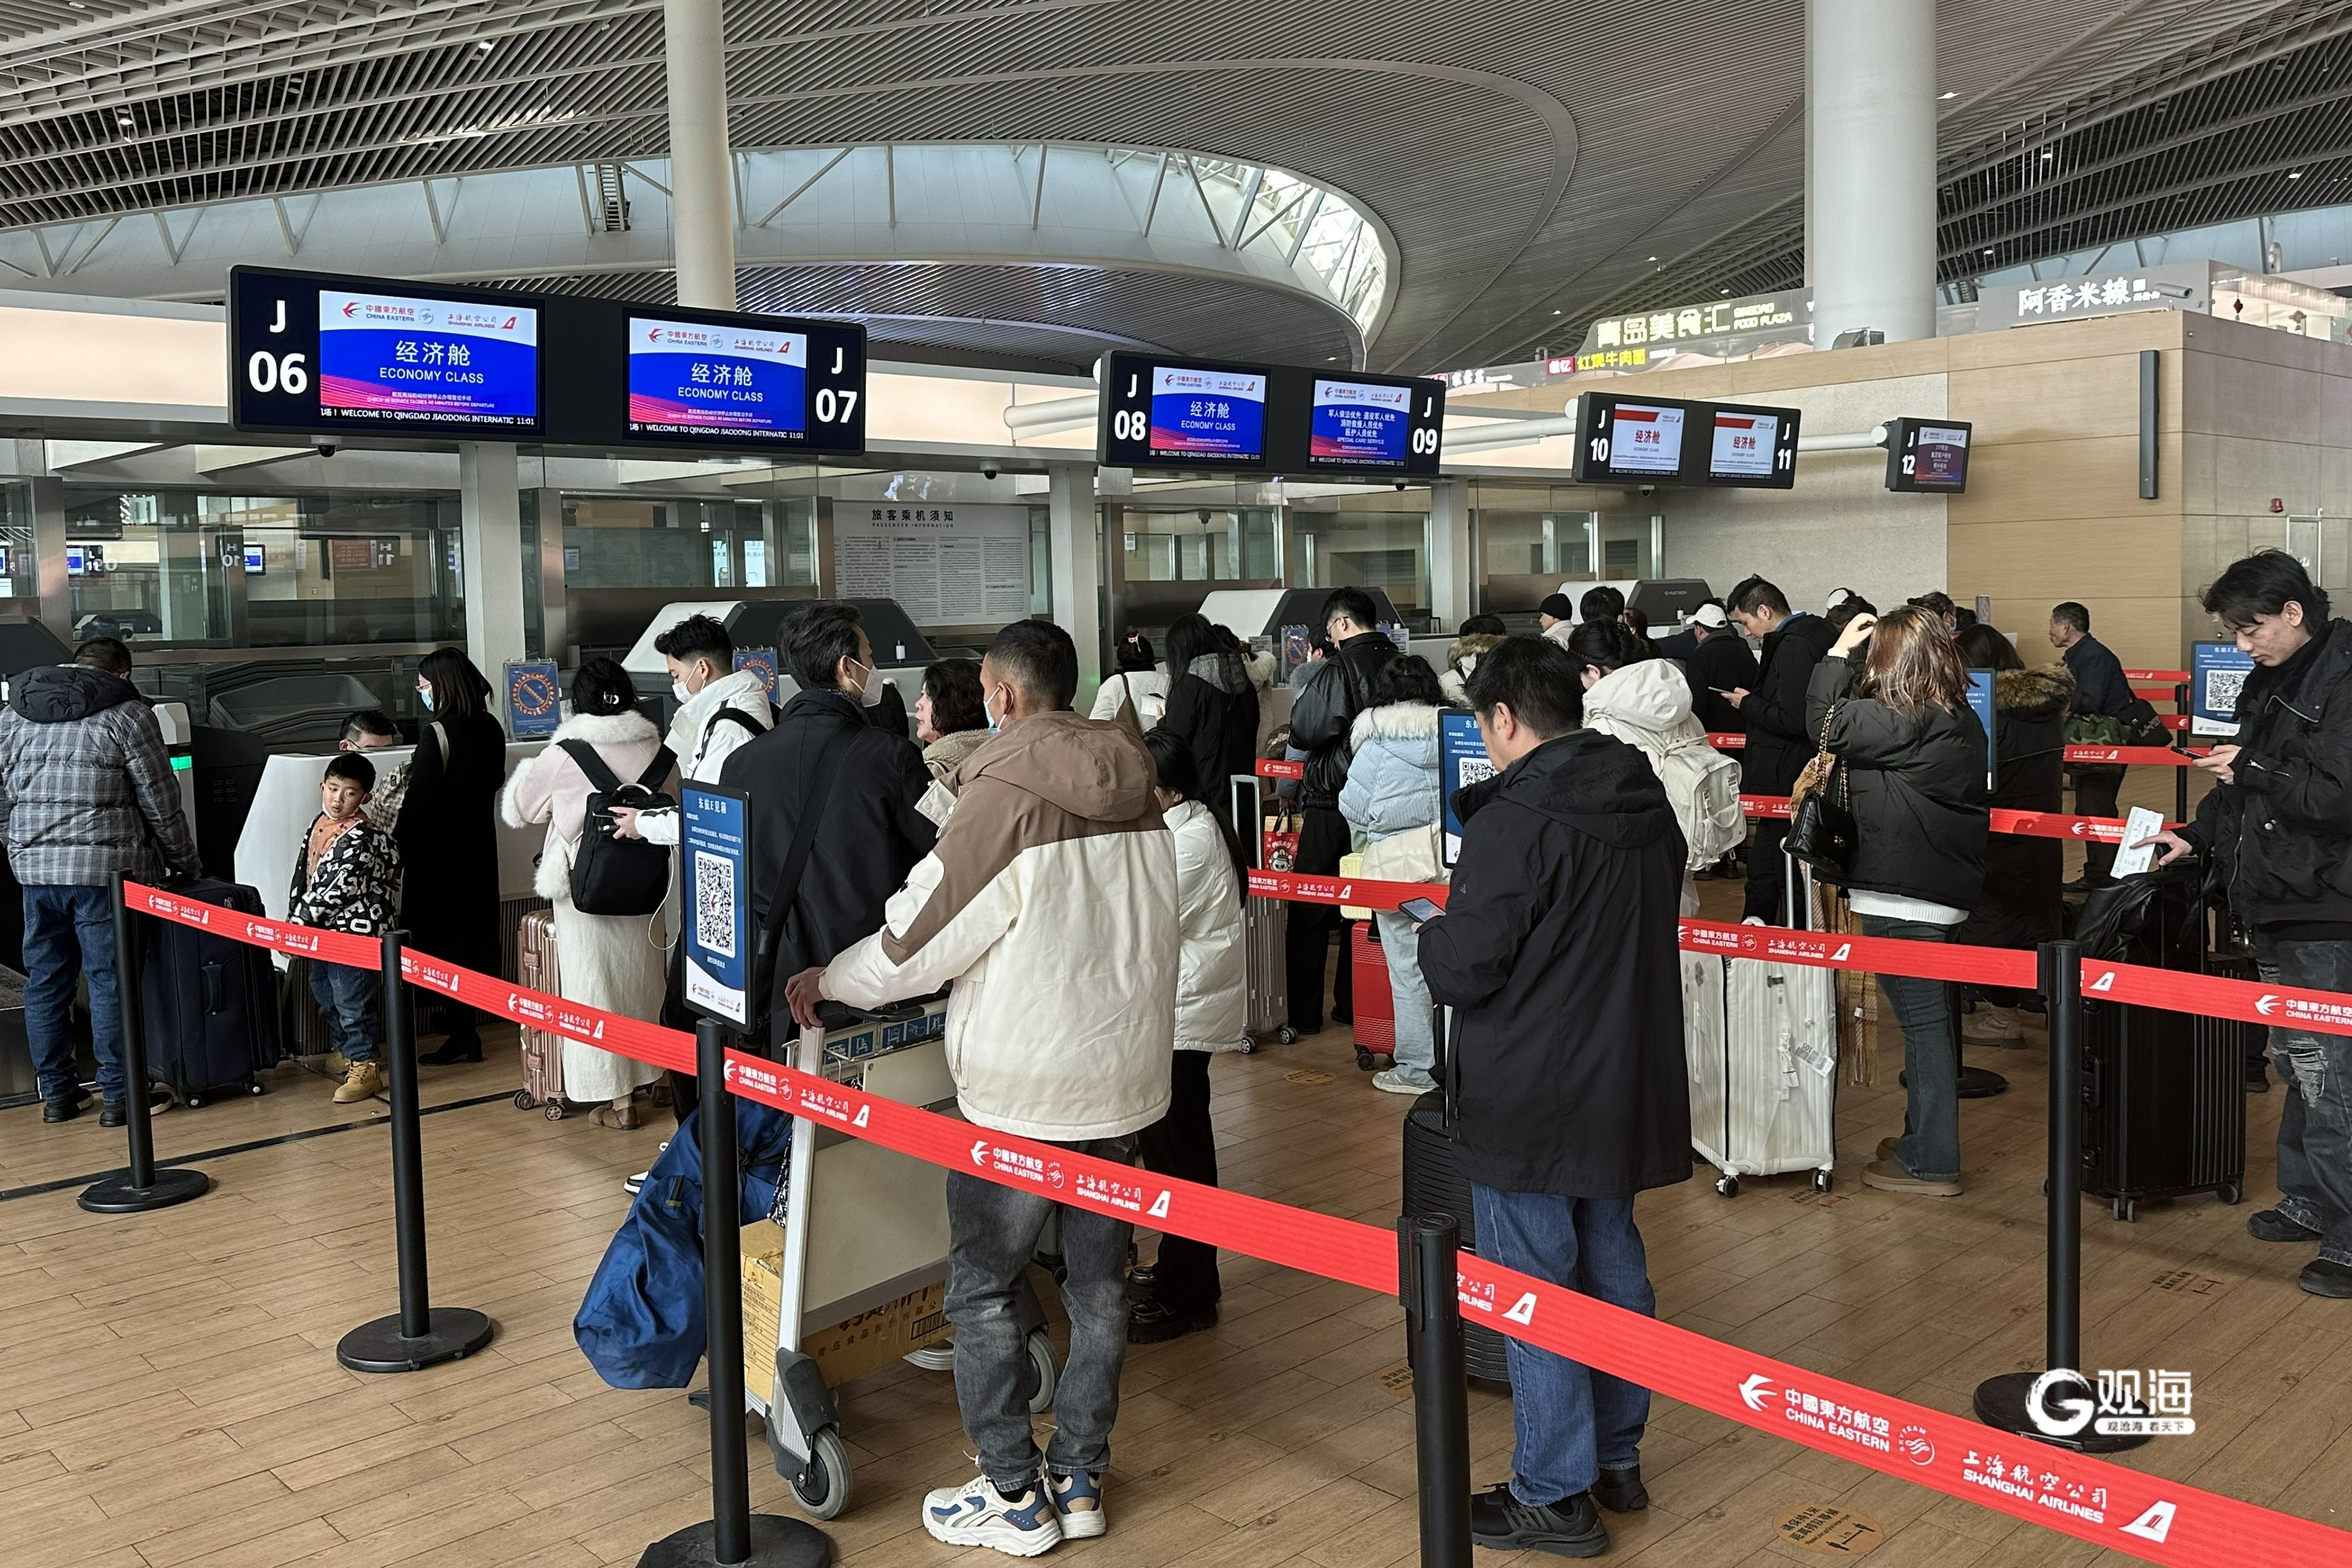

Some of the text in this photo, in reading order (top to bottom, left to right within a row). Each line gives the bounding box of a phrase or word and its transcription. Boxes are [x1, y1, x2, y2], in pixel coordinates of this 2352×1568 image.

[270, 300, 286, 333] J
[366, 305, 414, 315] 中國東方航空
[1760, 312, 1793, 327] PLAZA
[1597, 304, 1731, 348] 青岛美食汇
[396, 341, 470, 366] 经济舱
[831, 347, 843, 374] J
[1578, 350, 1645, 371] 红烧牛肉面
[249, 351, 307, 394] 06
[380, 367, 484, 383] ECONOMY CLASS
[692, 363, 753, 386] 经济舱
[678, 387, 763, 402] ECONOMY CLASS
[1127, 374, 1137, 399] J
[342, 410, 380, 418] WELCOME
[394, 412, 430, 421] QINGDAO
[432, 413, 470, 422] JIAODONG
[815, 388, 857, 424] 07
[1190, 401, 1229, 418] 经济舱
[1424, 397, 1432, 418] J
[1114, 410, 1146, 441] 08
[1181, 420, 1235, 431] ECONOMY CLASS
[1598, 410, 1606, 429] J
[1345, 428, 1377, 438] 医护人员优先
[1413, 428, 1437, 454] 09
[1635, 429, 1660, 444] 经济舱
[1783, 423, 1790, 440] J
[1908, 432, 1914, 447] J
[1591, 438, 1608, 461] 10
[1733, 436, 1756, 449] 经济舱
[1778, 448, 1791, 470] 11
[1902, 455, 1915, 475] 12
[872, 509, 954, 521] 旅客乘机须知
[1692, 929, 1738, 942] 中國東方航空
[1712, 939, 1738, 948] EASTERN
[2286, 999, 2352, 1017] 中國東方航空
[2286, 1010, 2352, 1026] CHINA EASTERN
[739, 1065, 777, 1084] 中國東方航空
[739, 1076, 777, 1095] CHINA EASTERN
[801, 1099, 848, 1121] SHANGHAI AIRLINES
[993, 1147, 1043, 1171] 中國東方航空
[993, 1161, 1044, 1183] CHINA EASTERN
[1076, 1174, 1141, 1201] 上海航空公司
[1076, 1187, 1140, 1211] SHANGHAI AIRLINES
[1786, 1388, 1890, 1437] 中國東方航空
[1786, 1408, 1890, 1453] CHINA EASTERN
[1898, 1425, 1926, 1452] SKYTEAM
[1963, 1450, 2106, 1510] 上海航空公司
[1963, 1468, 2104, 1524] SHANGHAI AIRLINES
